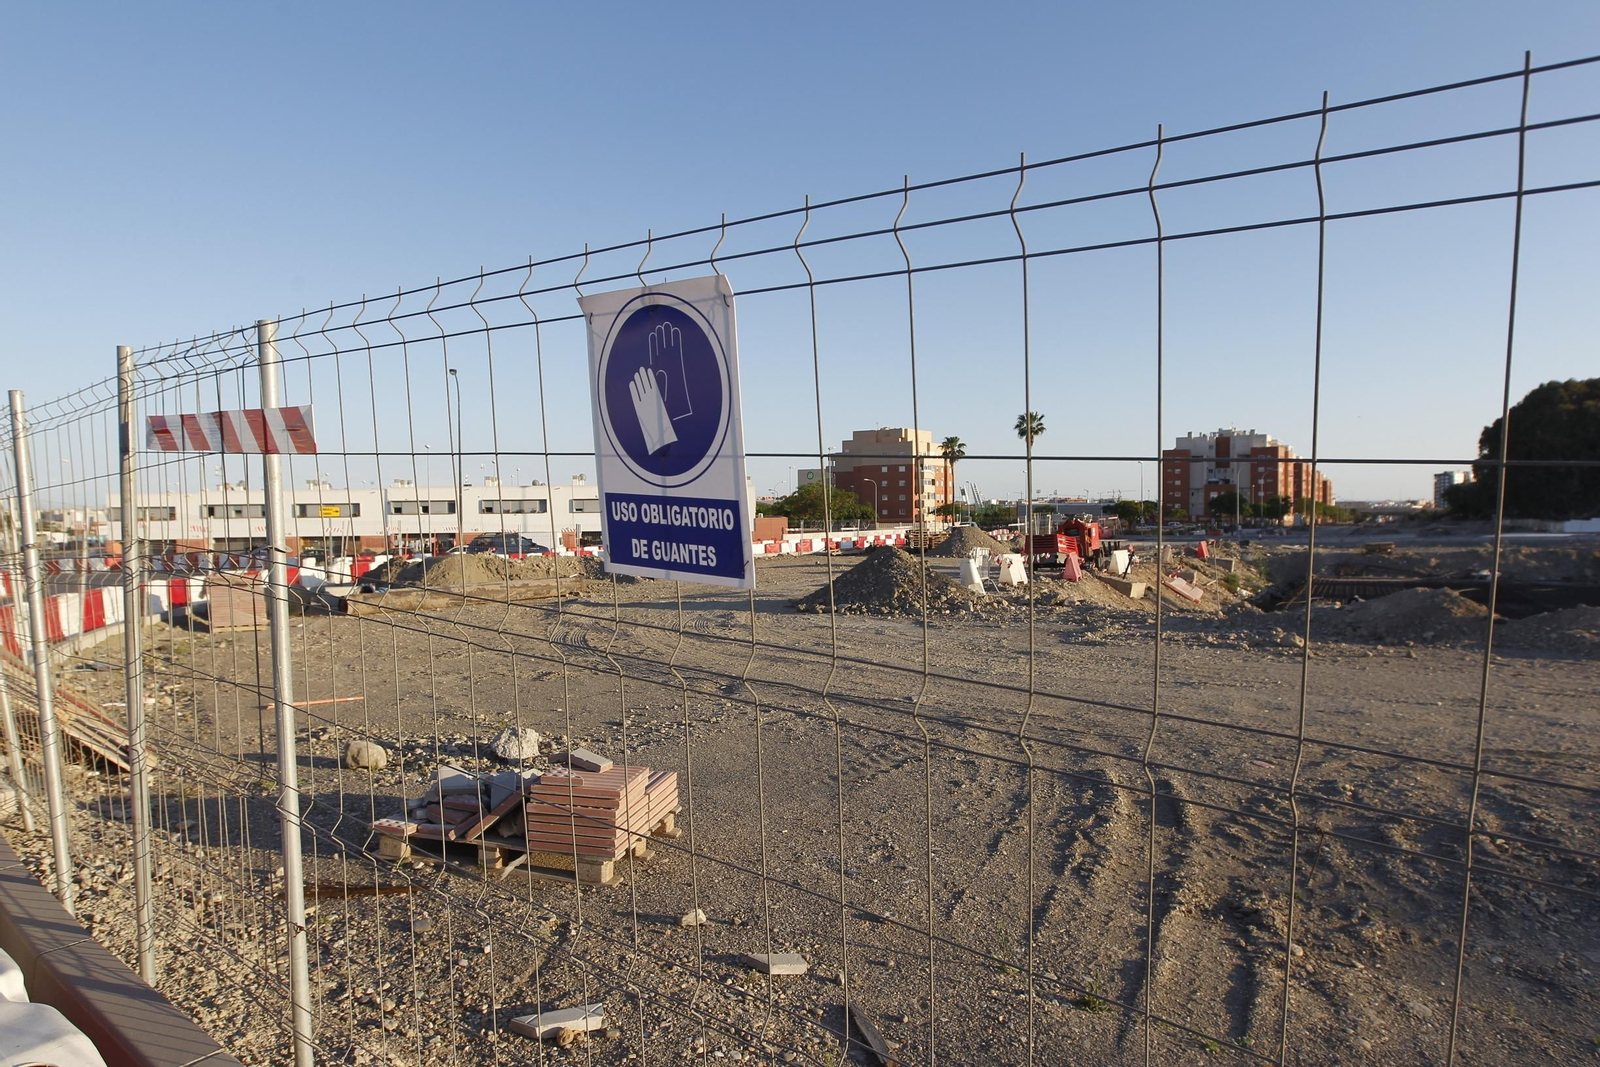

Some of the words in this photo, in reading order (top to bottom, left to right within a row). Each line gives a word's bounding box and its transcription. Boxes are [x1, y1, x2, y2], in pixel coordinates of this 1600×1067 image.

[612, 501, 637, 522] USO
[641, 503, 734, 530] OBLIGATORIO
[632, 538, 648, 559] DE
[652, 540, 717, 567] GUANTES
